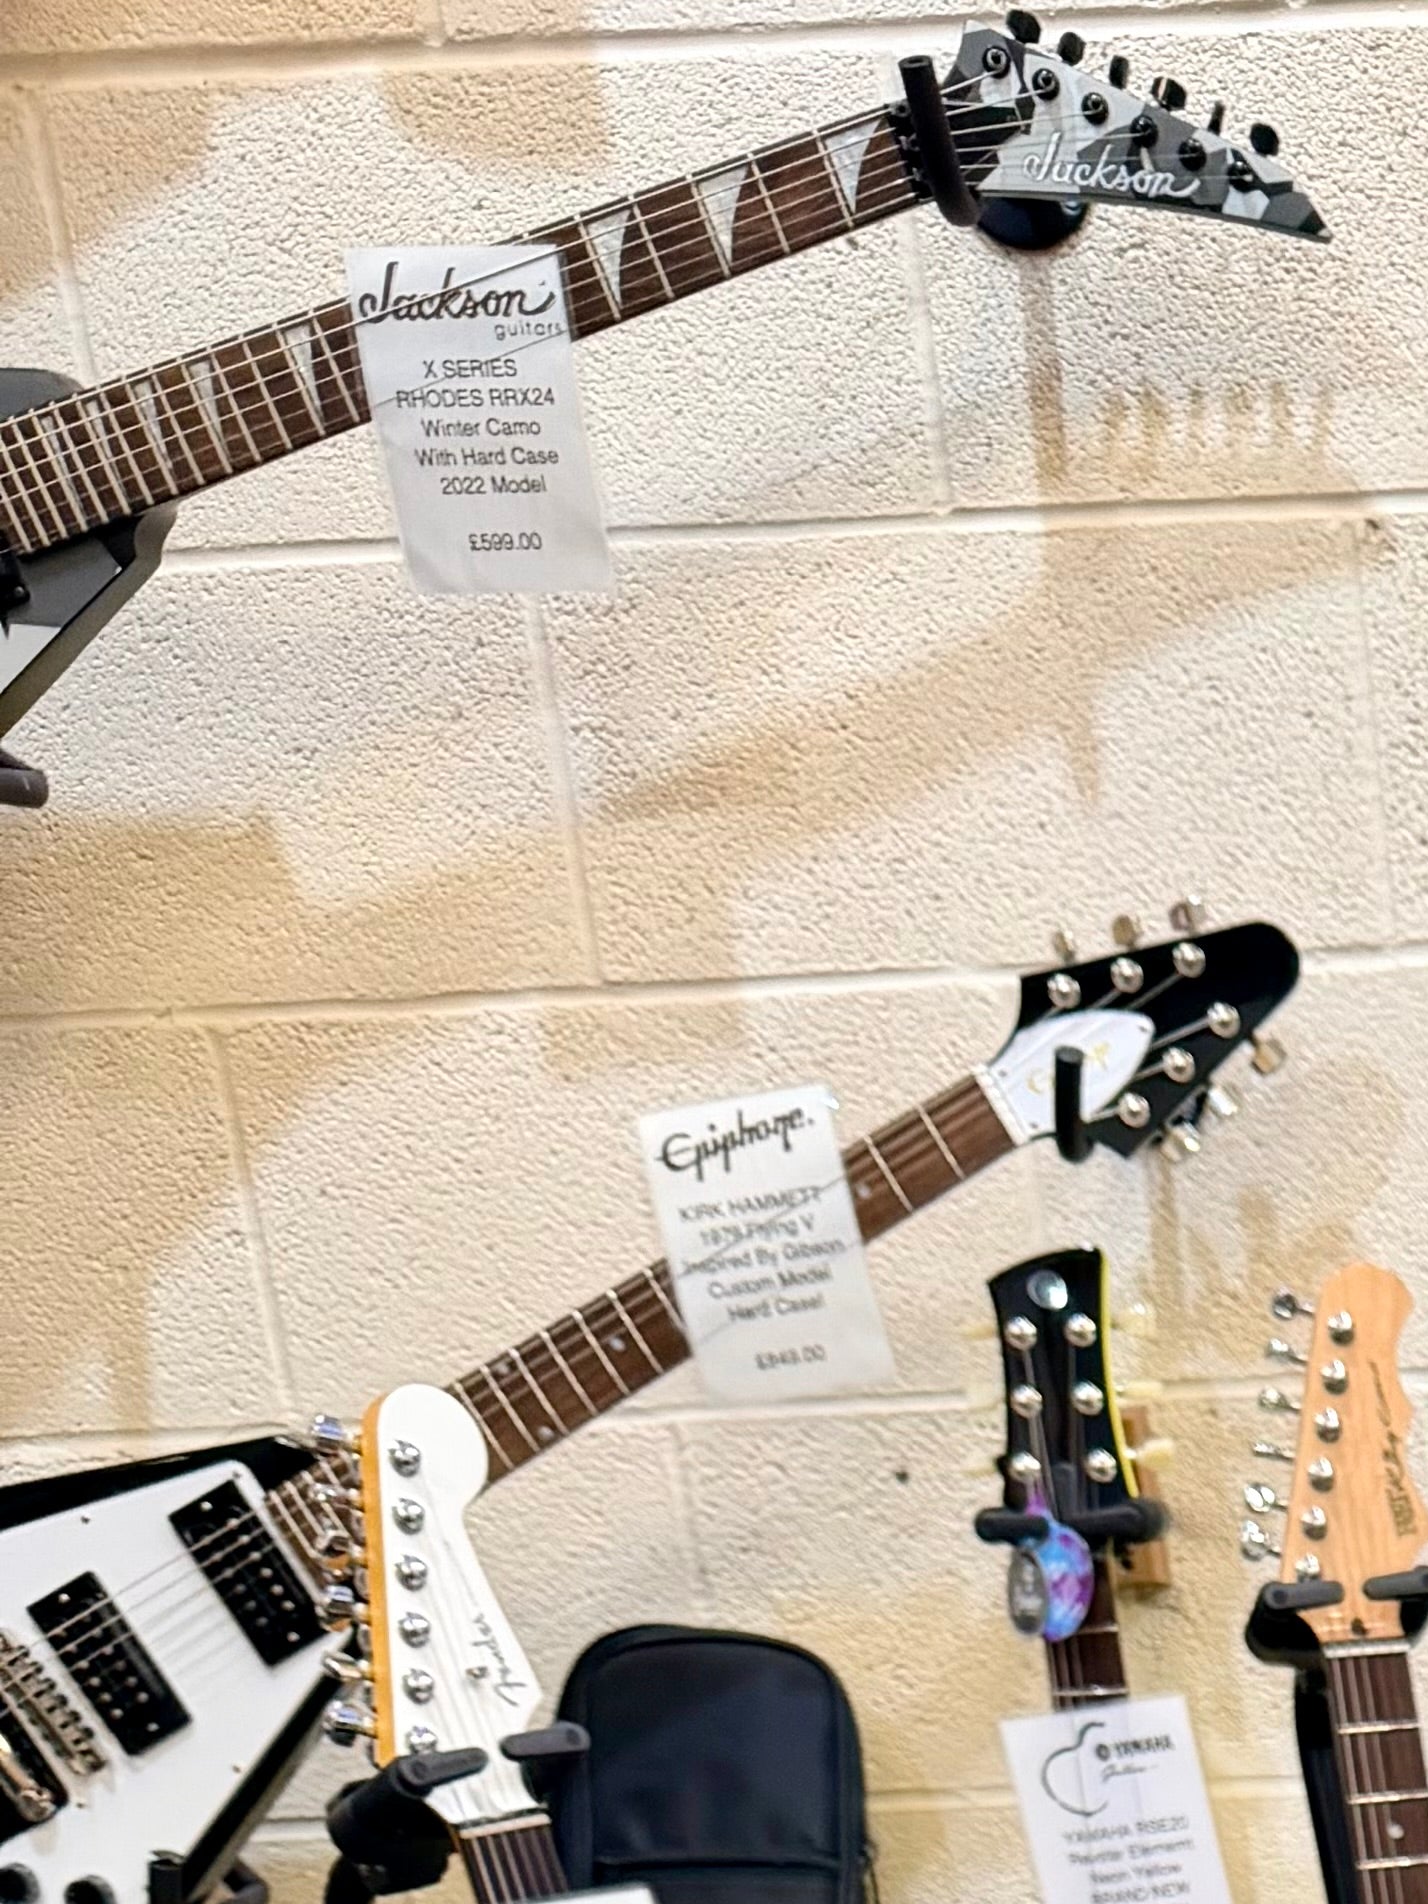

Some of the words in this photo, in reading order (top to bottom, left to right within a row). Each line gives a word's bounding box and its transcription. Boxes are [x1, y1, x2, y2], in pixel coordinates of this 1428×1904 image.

[1023, 132, 1201, 199] Jackson
[359, 261, 556, 324] Jackson
[423, 361, 437, 379] X
[442, 359, 517, 378] SERIES
[396, 389, 485, 408] RHODES
[490, 387, 556, 407] RRX24
[422, 419, 479, 437] Winter
[486, 418, 541, 436] Camo
[415, 448, 457, 466] With
[461, 447, 506, 465] Hard
[511, 447, 559, 465] Case
[440, 477, 487, 495] 2022
[492, 475, 546, 493] Model
